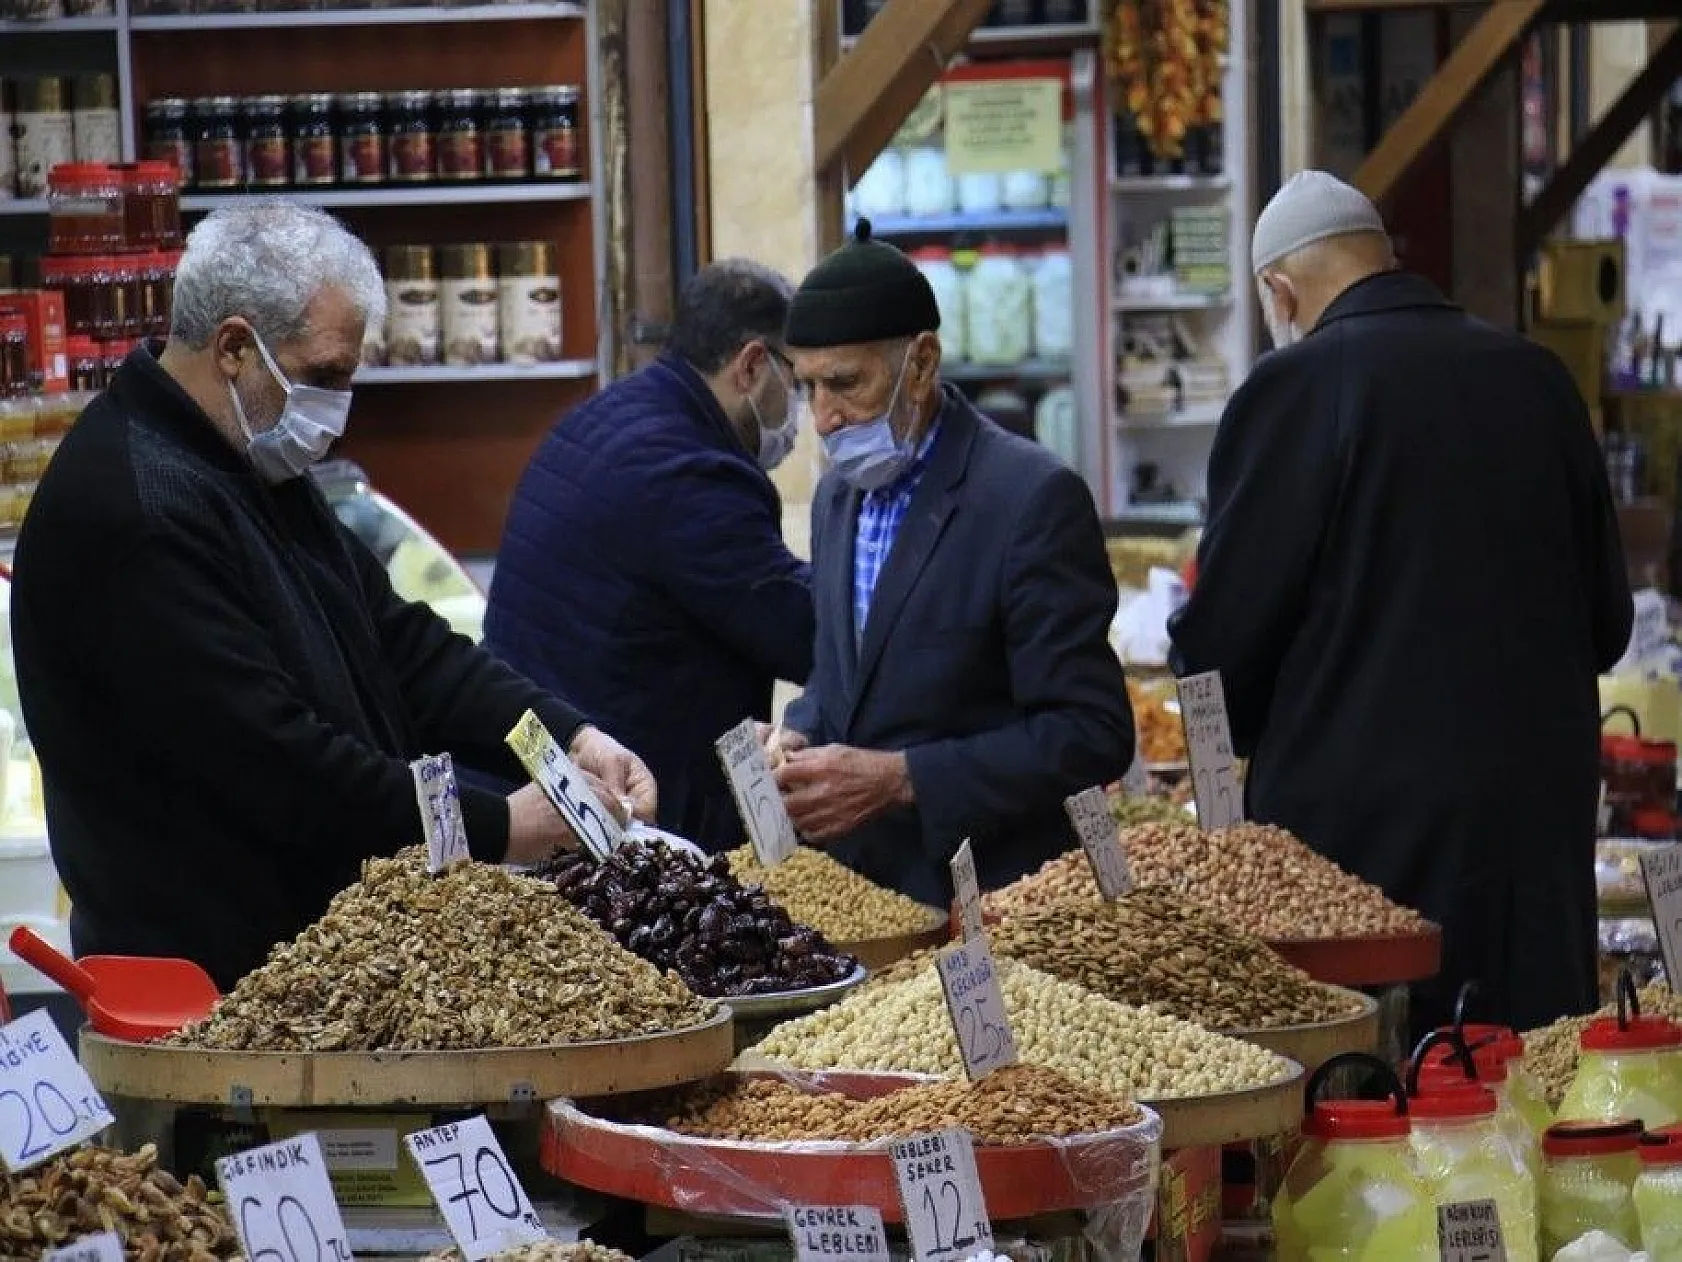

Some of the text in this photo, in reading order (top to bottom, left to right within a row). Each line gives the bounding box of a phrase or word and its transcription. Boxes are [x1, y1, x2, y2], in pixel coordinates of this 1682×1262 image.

[959, 997, 1002, 1064] 25
[424, 1146, 521, 1241] 70
[794, 1207, 860, 1228] GEVREK
[923, 1180, 976, 1256] 12
